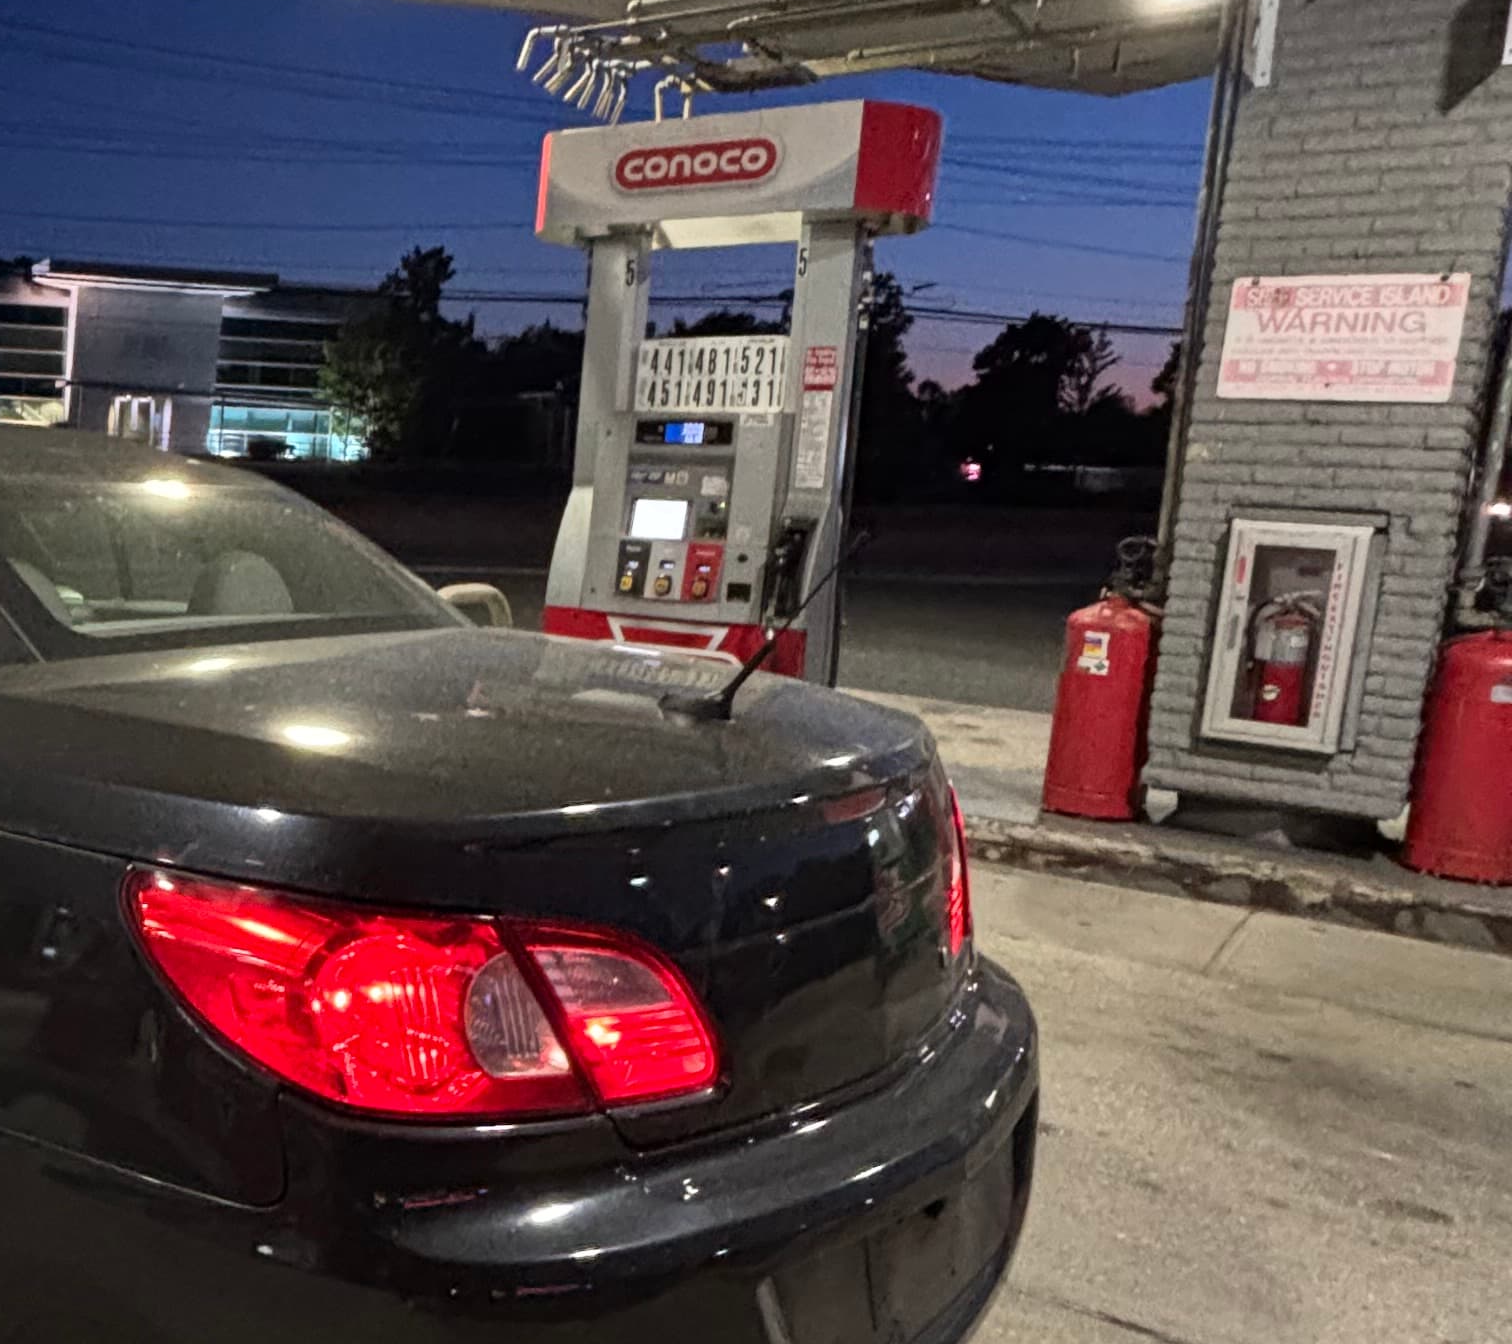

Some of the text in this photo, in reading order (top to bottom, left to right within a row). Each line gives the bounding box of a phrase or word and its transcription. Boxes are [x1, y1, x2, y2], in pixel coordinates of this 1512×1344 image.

[625, 259, 635, 287] 5
[798, 247, 808, 278] 5
[1295, 285, 1377, 307] SERVICE
[1379, 284, 1451, 306] ISLAND
[1257, 310, 1428, 335] WARNING
